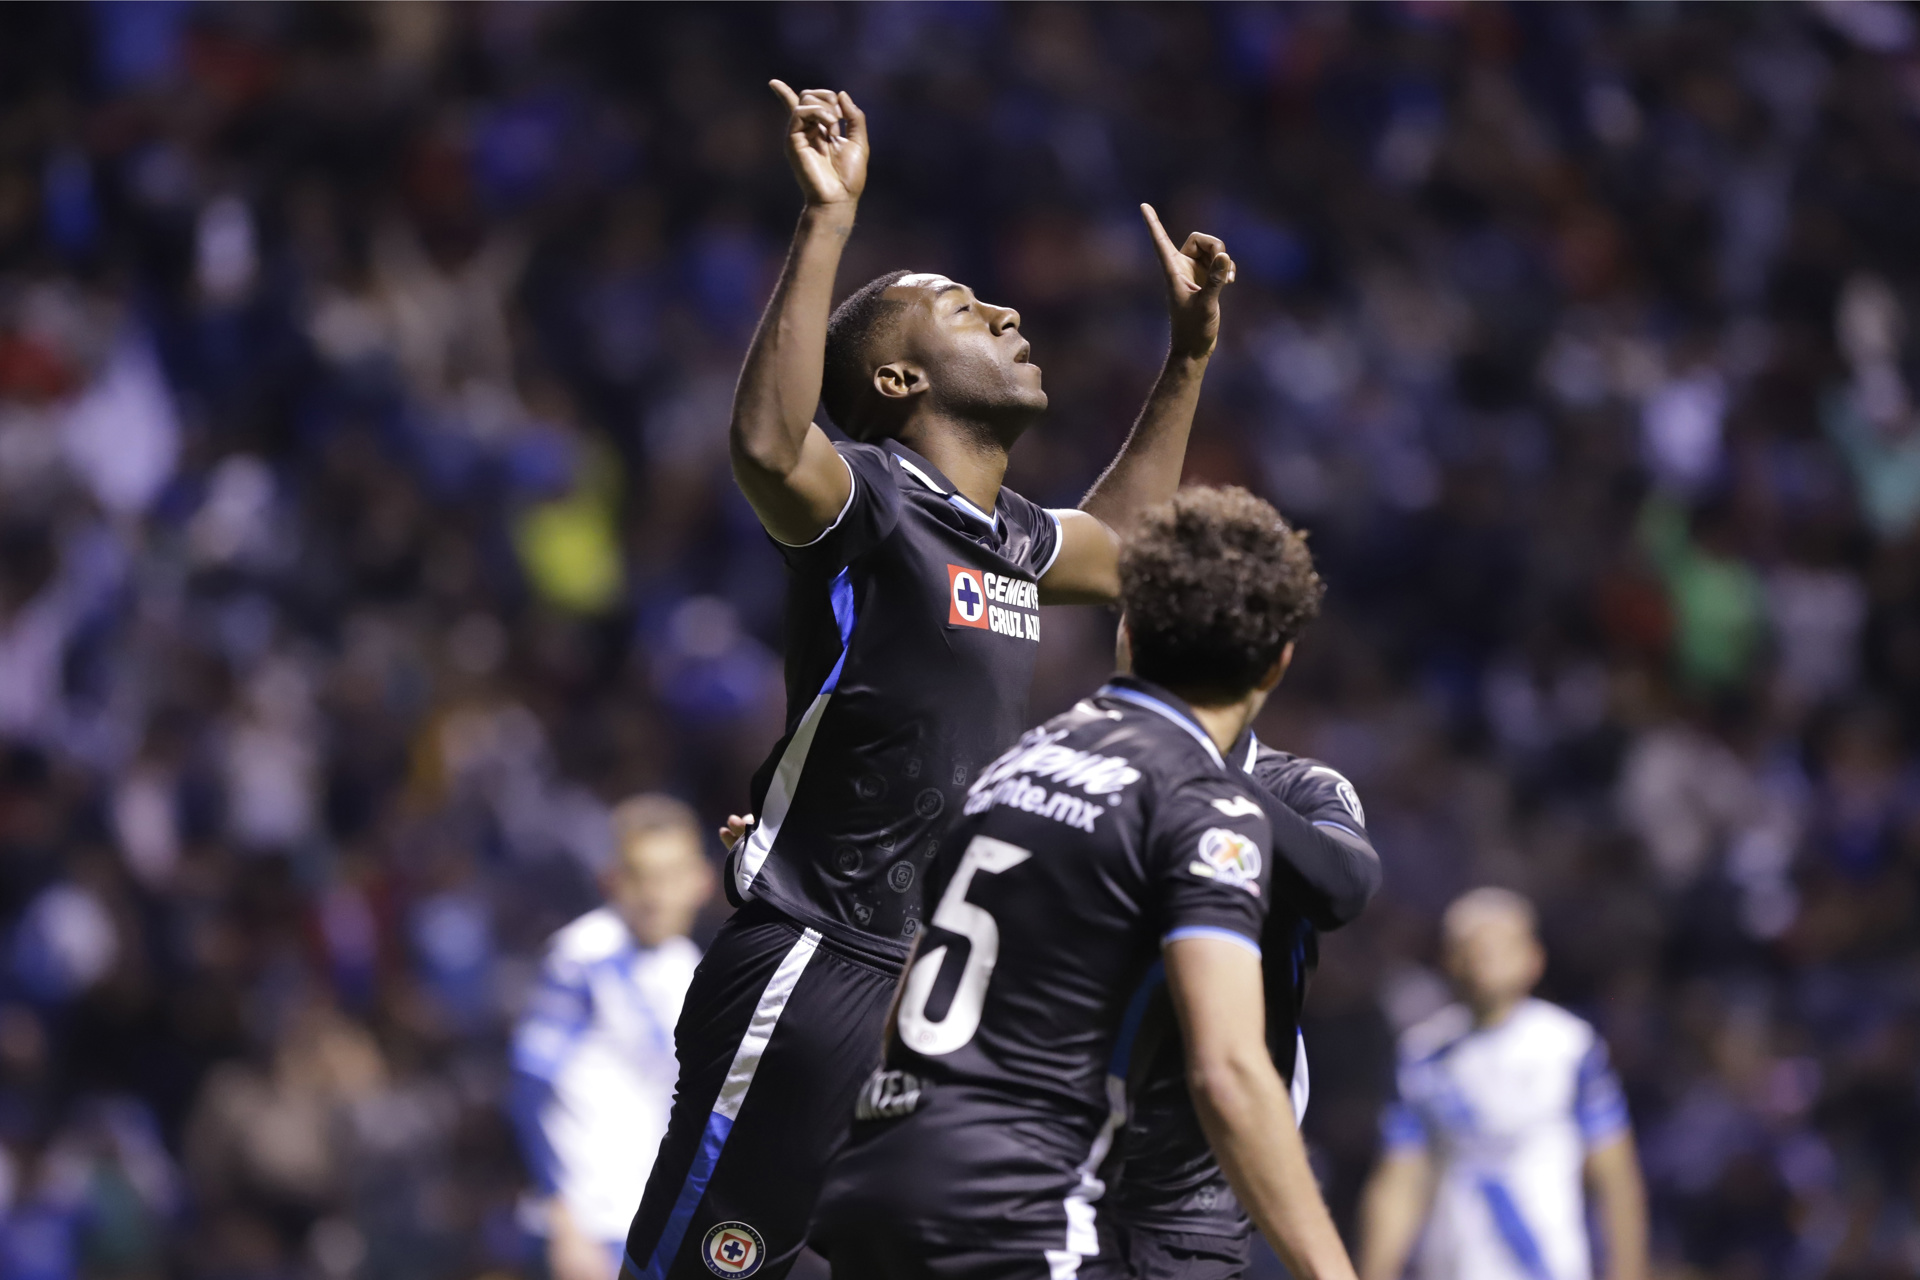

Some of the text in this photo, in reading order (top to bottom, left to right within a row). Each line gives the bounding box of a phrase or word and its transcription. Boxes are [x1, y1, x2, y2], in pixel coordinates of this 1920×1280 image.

[983, 572, 1039, 611] CEMENT
[988, 605, 1024, 639] CRUZ
[897, 834, 1033, 1056] 5
